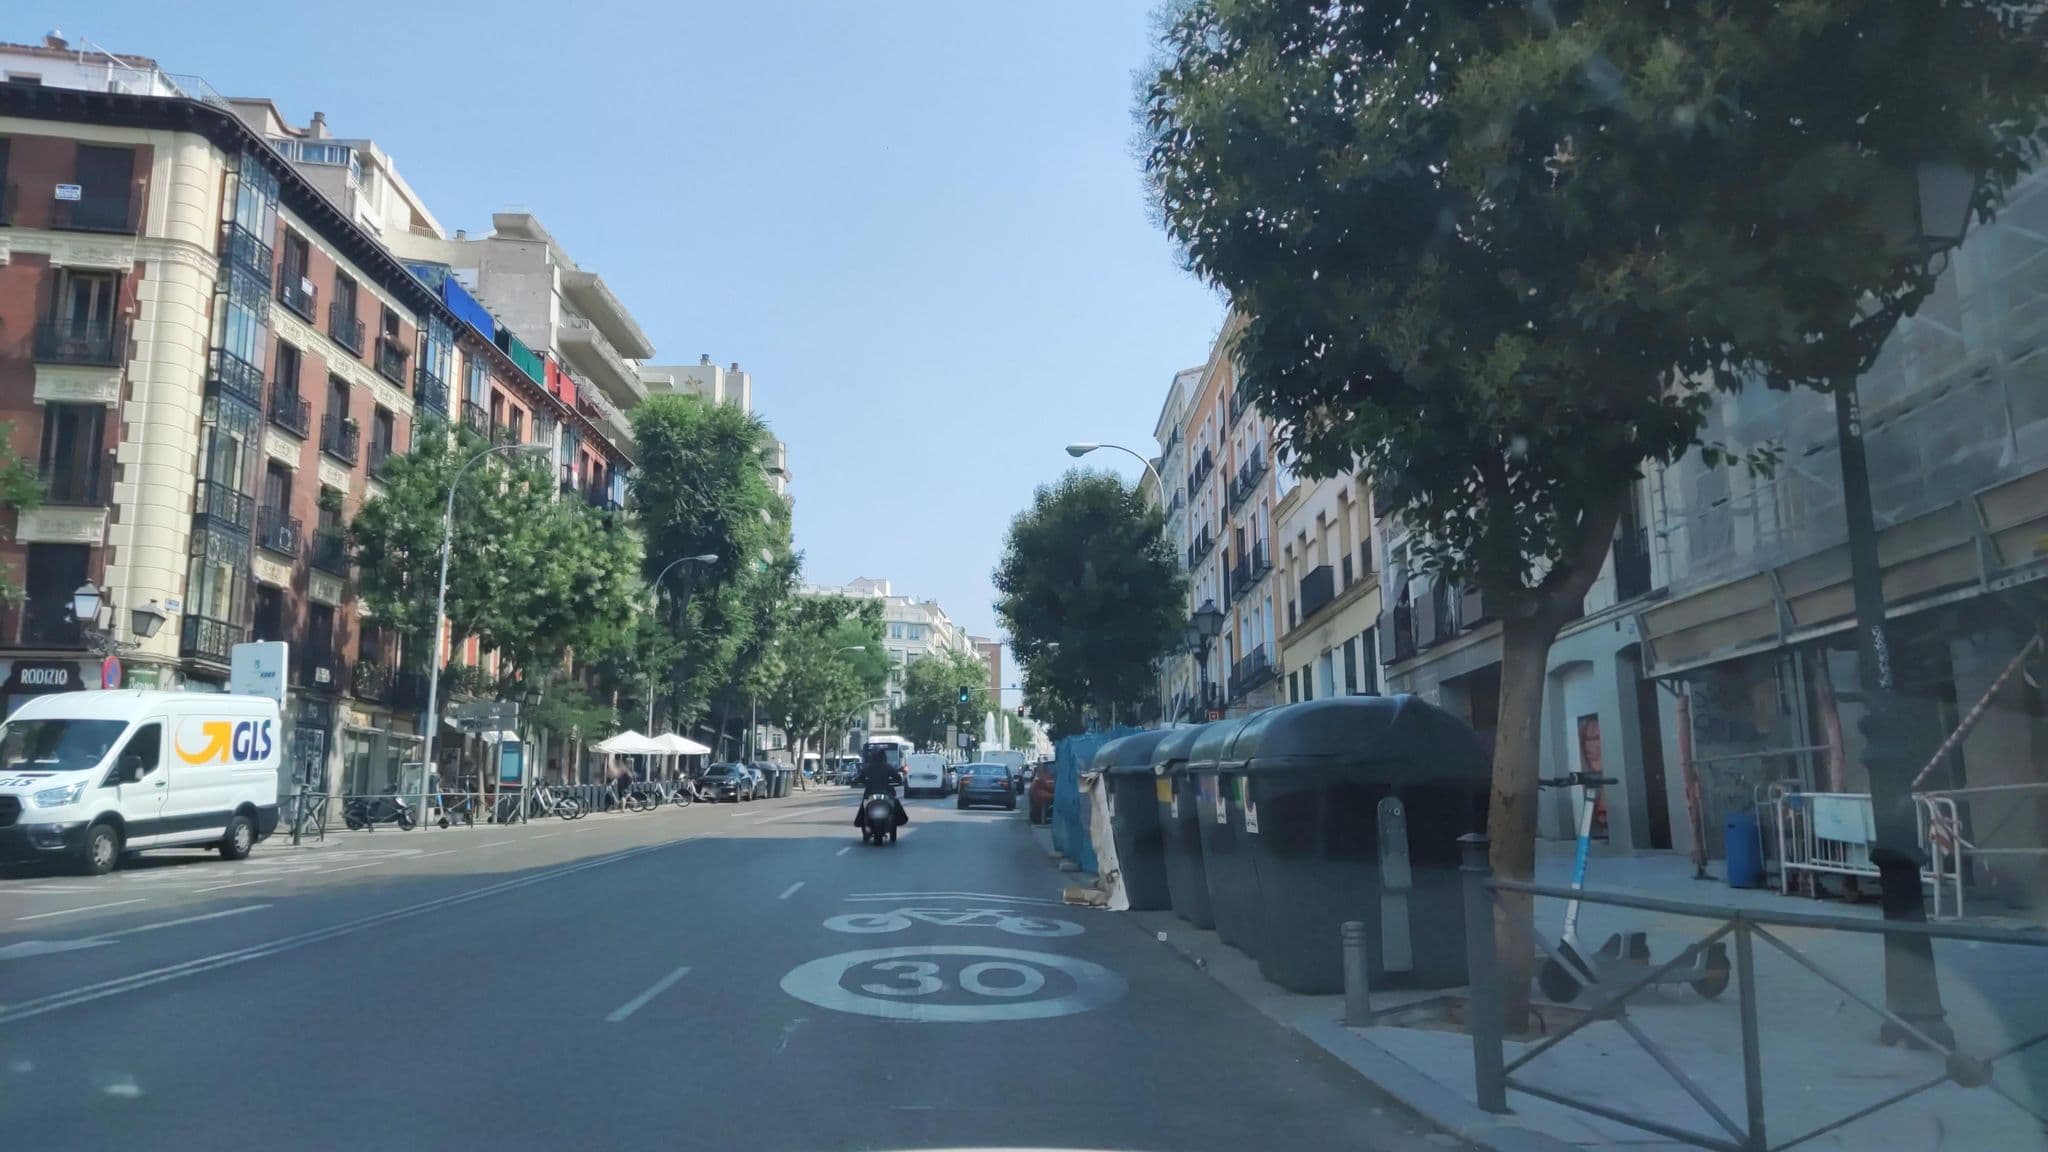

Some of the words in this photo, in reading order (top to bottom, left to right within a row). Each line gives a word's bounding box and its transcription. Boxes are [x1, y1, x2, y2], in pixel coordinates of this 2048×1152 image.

[20, 668, 69, 686] RODIZIO
[232, 719, 272, 762] GLS
[860, 960, 1046, 997] 30
